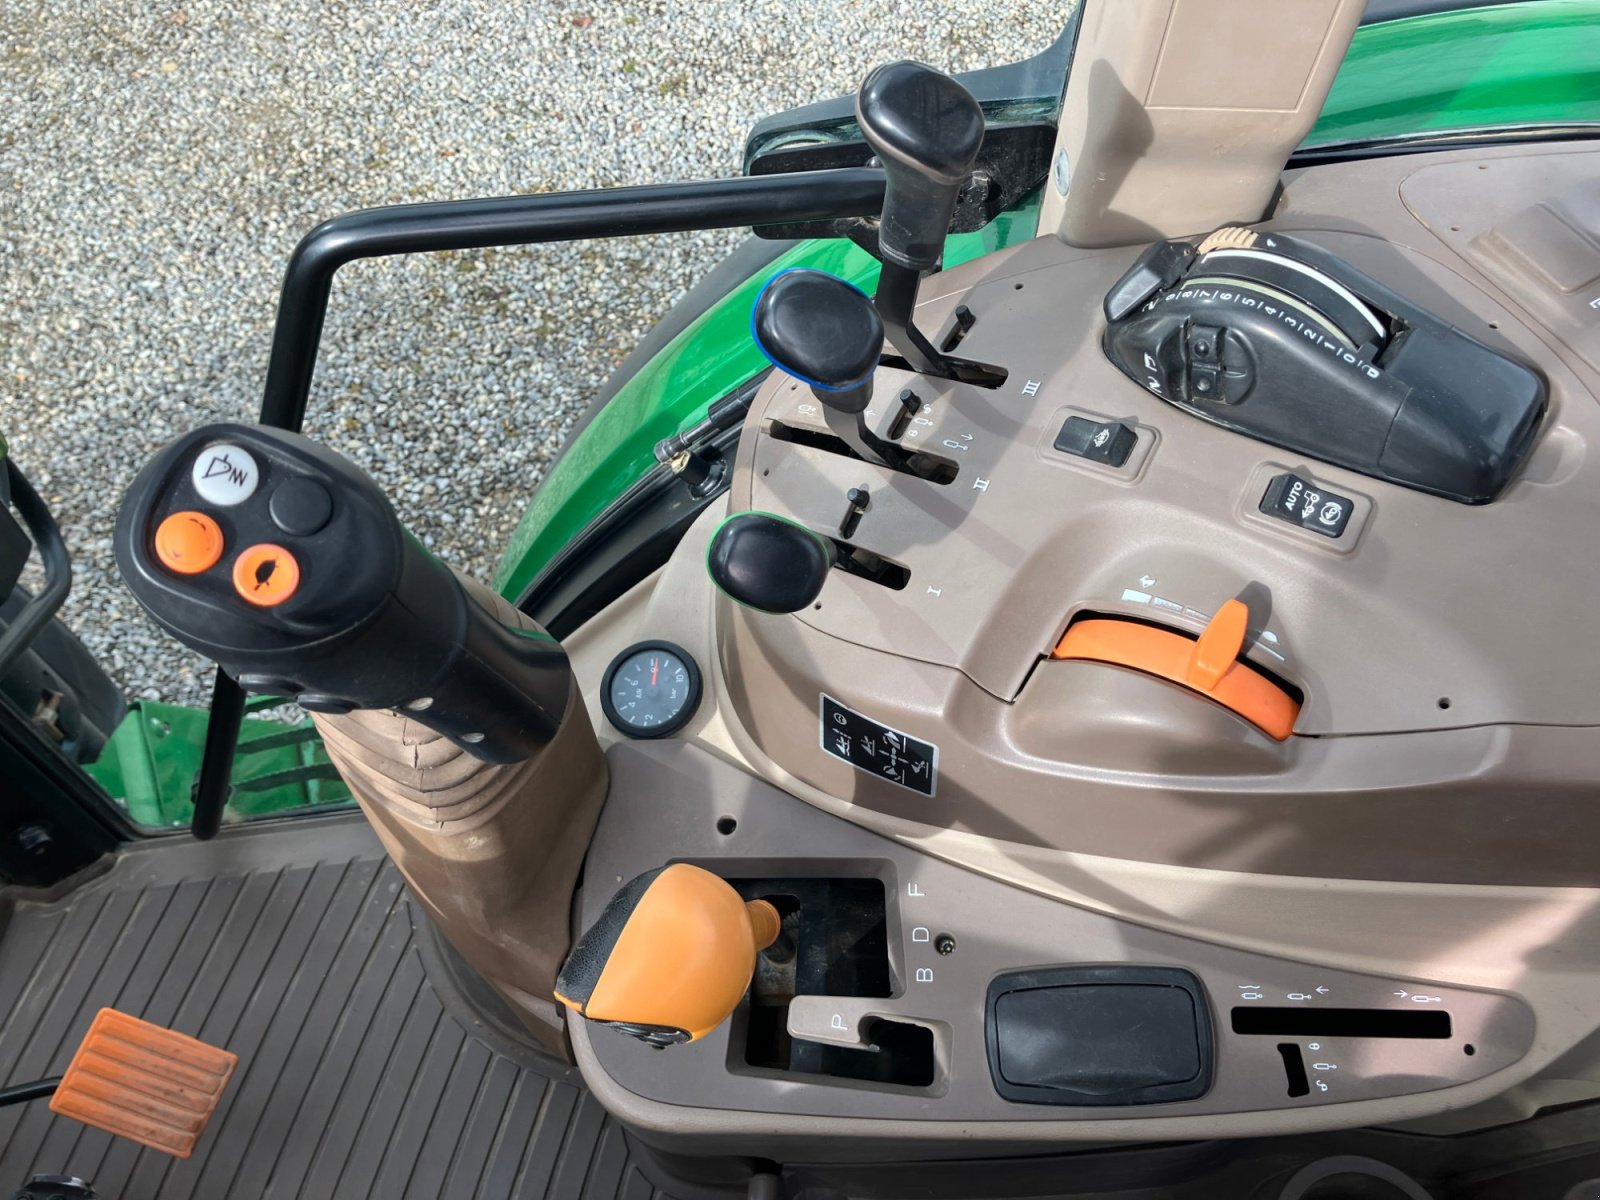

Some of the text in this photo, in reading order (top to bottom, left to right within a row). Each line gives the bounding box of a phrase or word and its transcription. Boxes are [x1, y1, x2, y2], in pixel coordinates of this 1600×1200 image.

[1182, 290, 1193, 298] 8
[1199, 290, 1211, 298] 7
[1220, 292, 1232, 300] 6
[1242, 298, 1256, 306] 5
[1264, 306, 1277, 315] 4
[1284, 316, 1297, 327] 3
[1304, 328, 1316, 340] 2
[1324, 341, 1336, 350] 1
[1343, 353, 1356, 363] 0
[1284, 481, 1303, 511] AUTO
[676, 674, 684, 683] 10
[669, 688, 677, 699] bar
[908, 882, 925, 896] F
[912, 927, 929, 942] D
[916, 968, 933, 982] B
[831, 1014, 848, 1031] P
